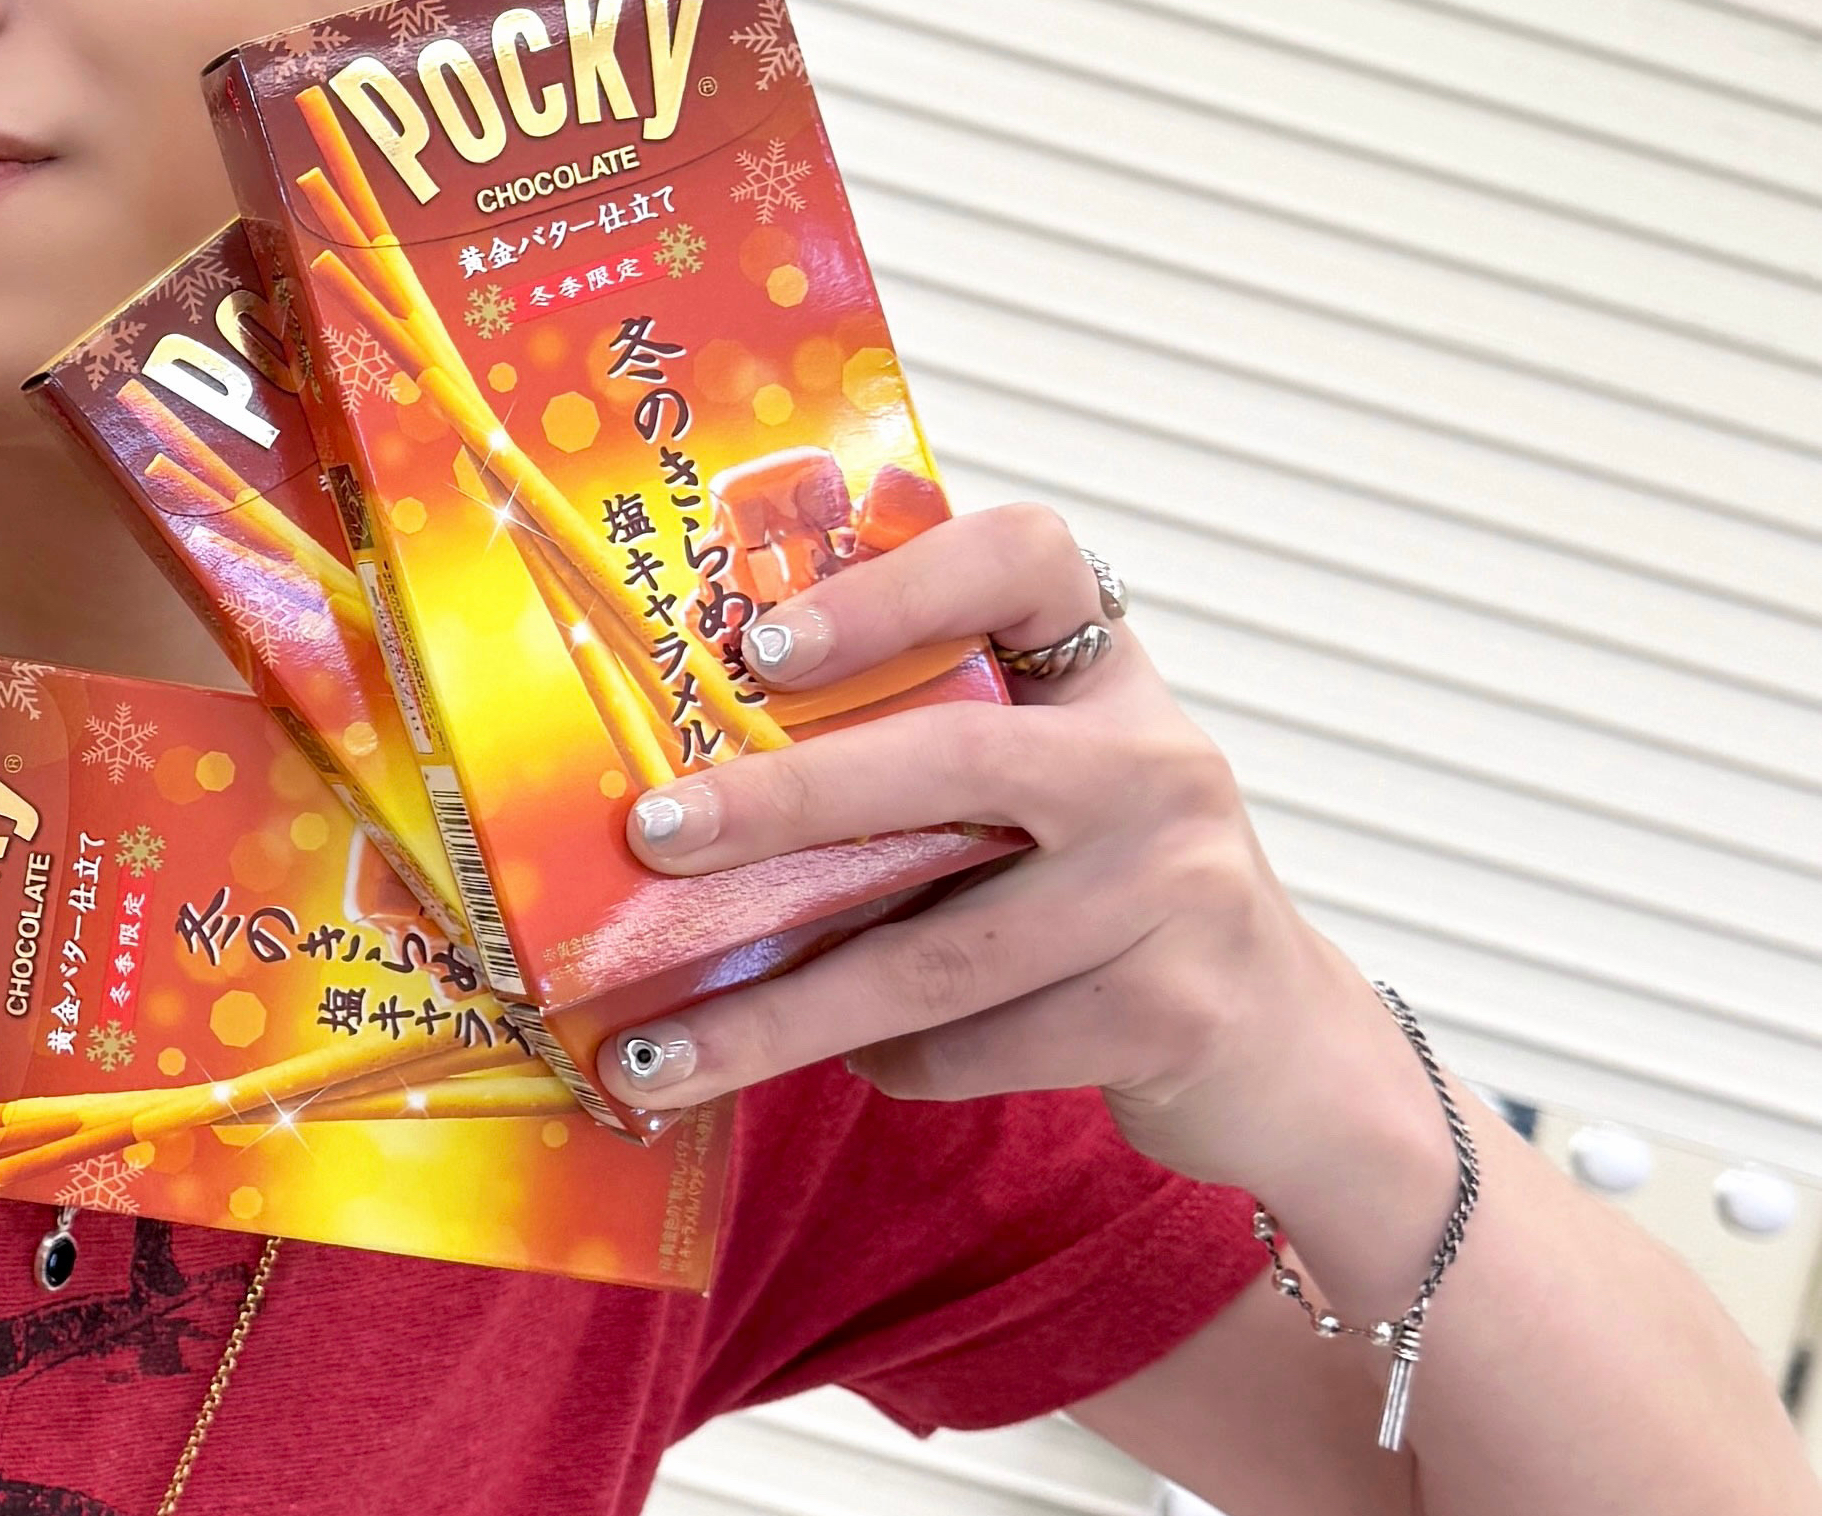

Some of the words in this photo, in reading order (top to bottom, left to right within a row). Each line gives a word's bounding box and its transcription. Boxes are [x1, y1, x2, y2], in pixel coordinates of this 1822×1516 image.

[458, 186, 677, 280] 黄金バター仕立て
[476, 144, 641, 214] CHOCOLATE
[530, 257, 644, 307] 冬季限定
[602, 493, 724, 767] 塩キャラメル
[6, 852, 52, 1016] CHOCOLATE
[47, 832, 106, 1055] 黄金バター仕立て
[109, 892, 146, 1009] 冬季限定
[175, 885, 480, 993] 冬のきらめ
[317, 987, 535, 1057] 塩キャラメ
